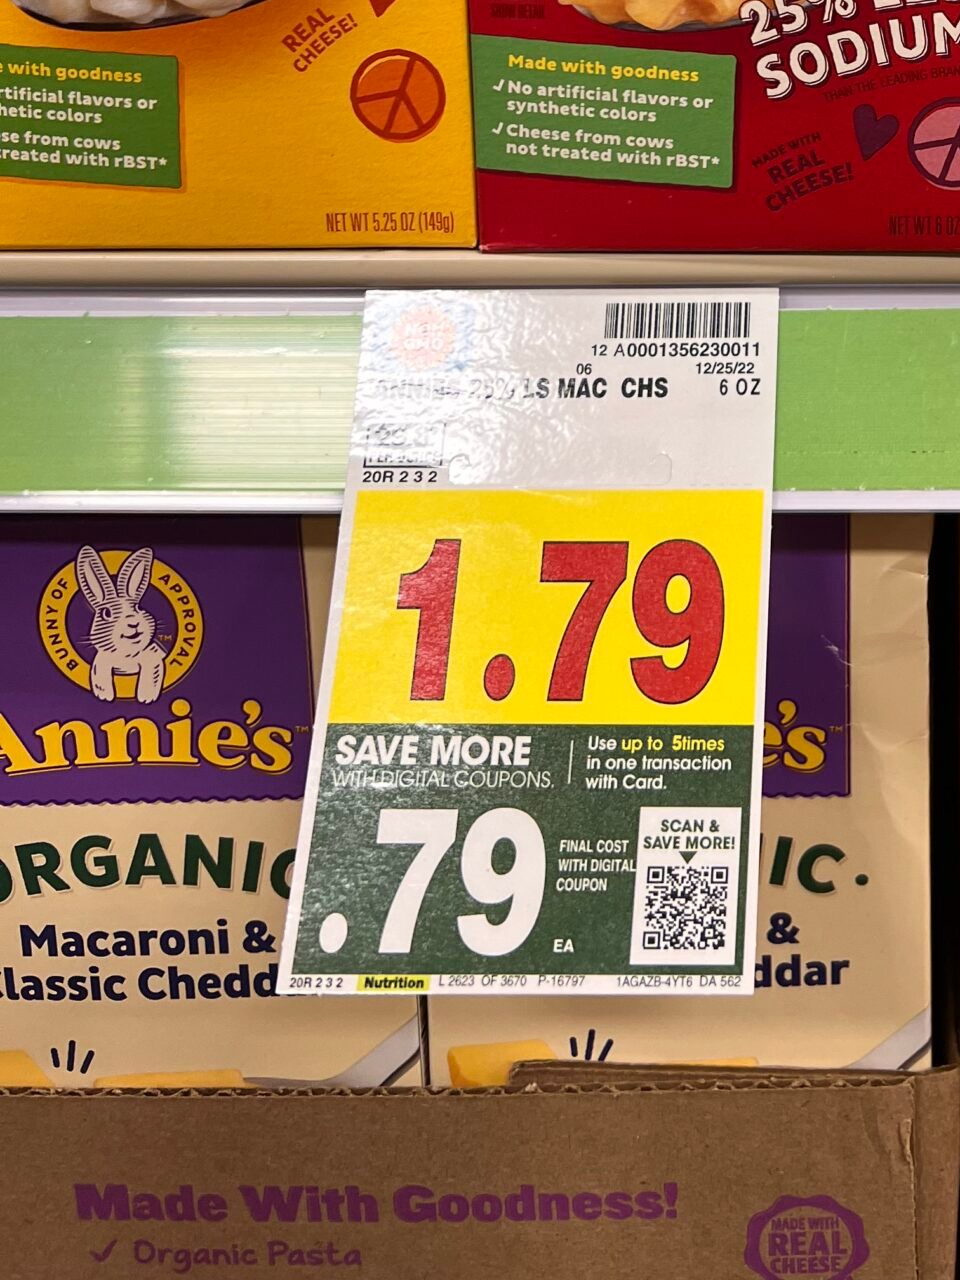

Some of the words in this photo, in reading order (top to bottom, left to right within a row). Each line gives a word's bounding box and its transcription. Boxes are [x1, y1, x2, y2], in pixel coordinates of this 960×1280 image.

[280, 6, 337, 54] REAL
[292, 11, 359, 74] CHEESE!
[508, 53, 557, 75] Made
[561, 57, 606, 77] with
[610, 61, 700, 83] goodness
[507, 81, 532, 97] No
[537, 82, 619, 103] artificial
[623, 89, 688, 108] flavors
[692, 97, 714, 109] or
[506, 98, 595, 120] synthetic
[599, 105, 657, 122] colors
[506, 124, 571, 144] Cheese
[575, 129, 621, 147] from
[626, 136, 674, 149] cows
[506, 143, 538, 156] not
[541, 144, 612, 163] treated
[616, 150, 661, 166] with
[326, 213, 347, 233] NET
[349, 213, 369, 232] WT
[372, 213, 398, 232] 5.25
[400, 213, 416, 232] OZ
[418, 213, 455, 234] (149g)
[591, 345, 608, 357] 12
[613, 342, 761, 358] A0001356230011
[576, 363, 593, 375] 06
[695, 362, 755, 374] 12/25/22
[558, 377, 608, 399] MAC
[620, 377, 669, 399] CHS
[720, 379, 730, 397] 6
[736, 379, 761, 396] OZ
[397, 538, 726, 704] 1.79
[335, 735, 420, 766] SAVE
[430, 735, 532, 766] MORE
[588, 736, 617, 751] Use
[621, 738, 643, 754] up
[647, 736, 664, 751] to
[672, 735, 725, 751] 5times
[586, 756, 601, 770] in
[605, 757, 637, 770] one
[642, 755, 732, 770] transaction
[332, 770, 376, 788] WITH
[377, 770, 450, 788] DIGITAL
[455, 770, 555, 788] COUPONS.
[586, 774, 618, 790] with
[622, 774, 667, 790] Card.
[661, 819, 704, 833] SCAN
[709, 819, 720, 832] &
[559, 839, 593, 853] FINAL
[596, 839, 630, 852] COST
[643, 836, 681, 849] SAVE
[686, 836, 736, 850] MORE!
[558, 859, 588, 872] WITH
[590, 859, 637, 872] DIGITAL
[319, 807, 547, 957] .79
[556, 878, 608, 892] COUPON
[20, 920, 229, 959] Macaroni
[242, 920, 276, 954] &
[553, 939, 575, 953] EA
[364, 976, 425, 990] Nutrition
[438, 975, 445, 986] L
[448, 975, 475, 987] 2623
[481, 975, 498, 986] OF
[501, 975, 527, 986] 3670
[537, 975, 585, 987] P-16797
[700, 976, 717, 987] DA
[720, 976, 742, 987] 562
[73, 1184, 228, 1222] Made
[238, 1184, 379, 1223] With
[392, 1182, 680, 1223] Goodness!
[771, 1217, 807, 1230] MADE
[808, 1217, 840, 1230] WITH
[768, 1231, 848, 1257] REAL
[133, 1239, 259, 1272] Organic
[267, 1240, 363, 1268] Pasta
[769, 1256, 841, 1274] CHEESE
